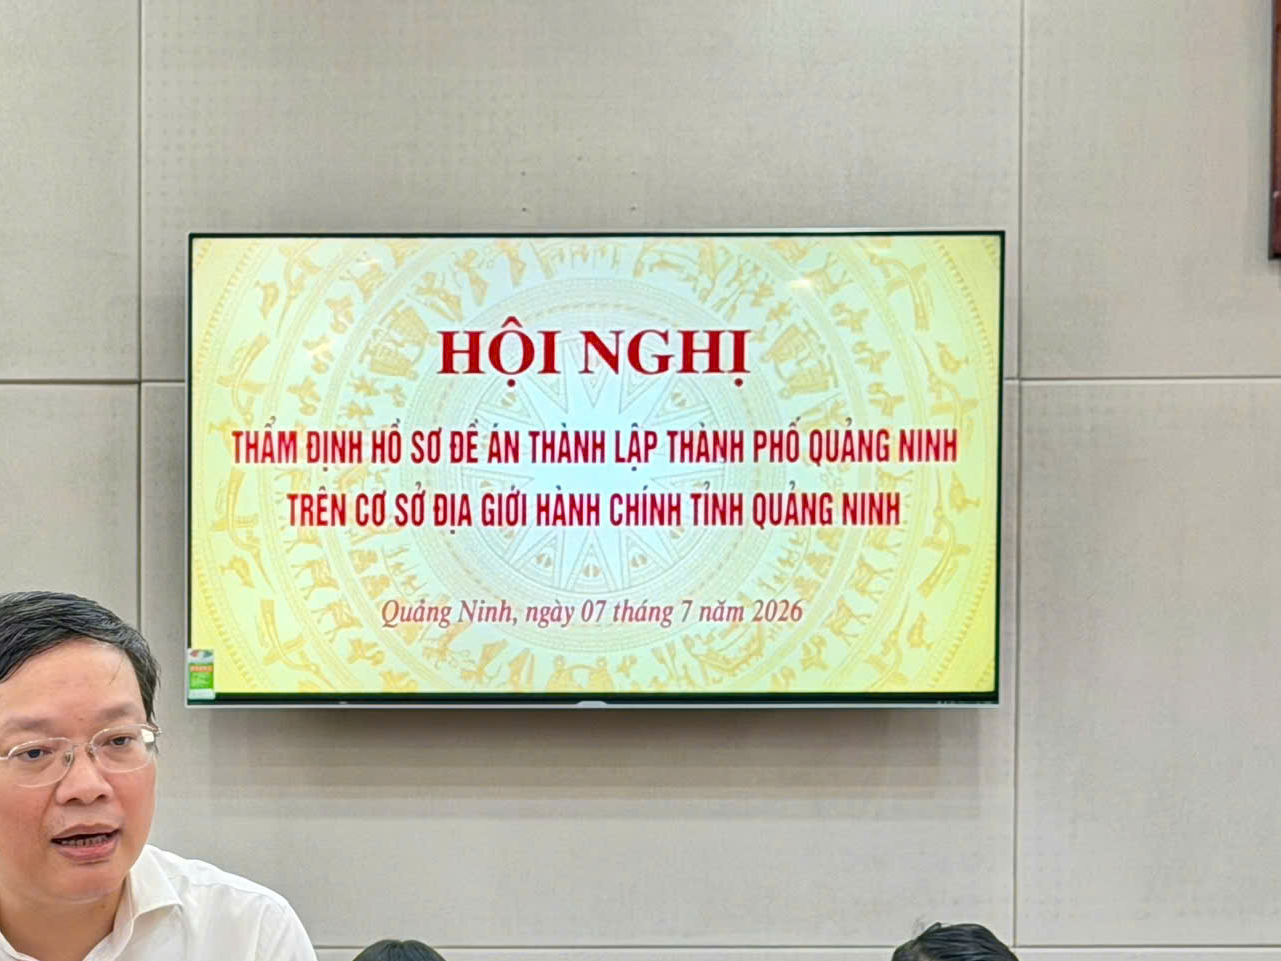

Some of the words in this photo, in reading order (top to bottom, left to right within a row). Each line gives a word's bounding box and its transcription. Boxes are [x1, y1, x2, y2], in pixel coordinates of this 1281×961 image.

[436, 315, 562, 388] HỘI
[578, 328, 752, 388] NGHỊ
[231, 416, 298, 464] THẨM
[306, 429, 364, 472] ĐỊNH
[371, 418, 403, 464] HỒ
[410, 426, 443, 464] SƠ
[449, 418, 480, 464] ĐỀ
[487, 422, 521, 464] ÁN
[528, 422, 607, 464] THÀNH
[614, 421, 659, 472] LẬP
[666, 421, 745, 464] THÀNH
[753, 415, 801, 463] PHỐ
[808, 416, 891, 467] QUẢNG
[899, 428, 959, 463] NINH
[286, 484, 347, 527] TRÊN
[355, 489, 387, 527] CƠ
[394, 480, 427, 527] SỞ
[433, 492, 471, 535] ĐỊA
[480, 484, 528, 527] GIỚI
[536, 484, 601, 527] HÀNH
[609, 484, 682, 527] CHÍNH
[690, 480, 744, 527] TỈNH
[752, 480, 833, 530] QUẢNG
[842, 491, 901, 527] NINH
[381, 599, 453, 629] Quảng
[457, 600, 519, 627] Ninh,
[525, 600, 575, 629] ngày
[580, 599, 607, 623] 07
[612, 599, 674, 629] tháng
[680, 599, 694, 623] 7
[698, 602, 745, 623] năm
[751, 598, 804, 623] 2026
